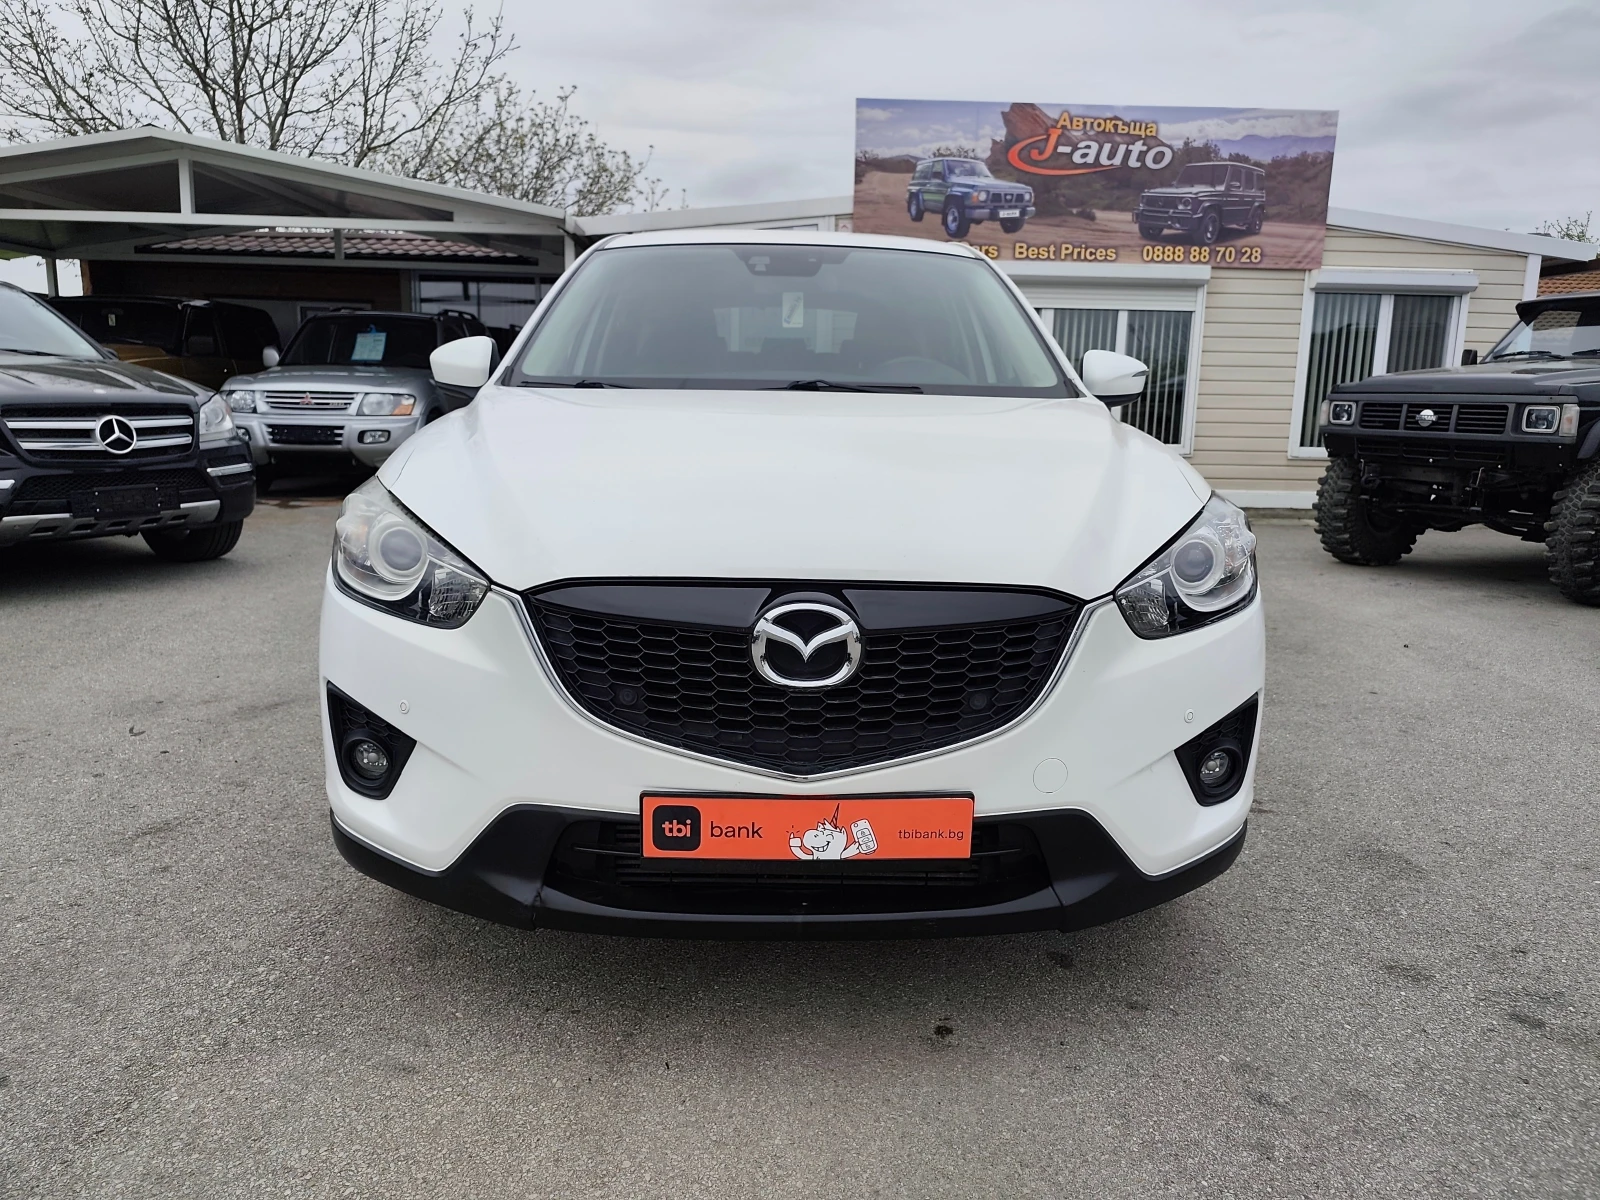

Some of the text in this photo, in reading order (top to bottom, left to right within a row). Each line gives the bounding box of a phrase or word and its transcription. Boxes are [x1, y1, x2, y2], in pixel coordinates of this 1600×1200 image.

[1057, 111, 1157, 138] Автокъща
[1030, 129, 1174, 170] J-auto
[1014, 243, 1056, 259] Best
[1060, 243, 1117, 260] Prices
[1142, 245, 1262, 263] 0888 88 70 28
[661, 819, 763, 839] tbi bank
[897, 828, 964, 841] tbibank.bg
